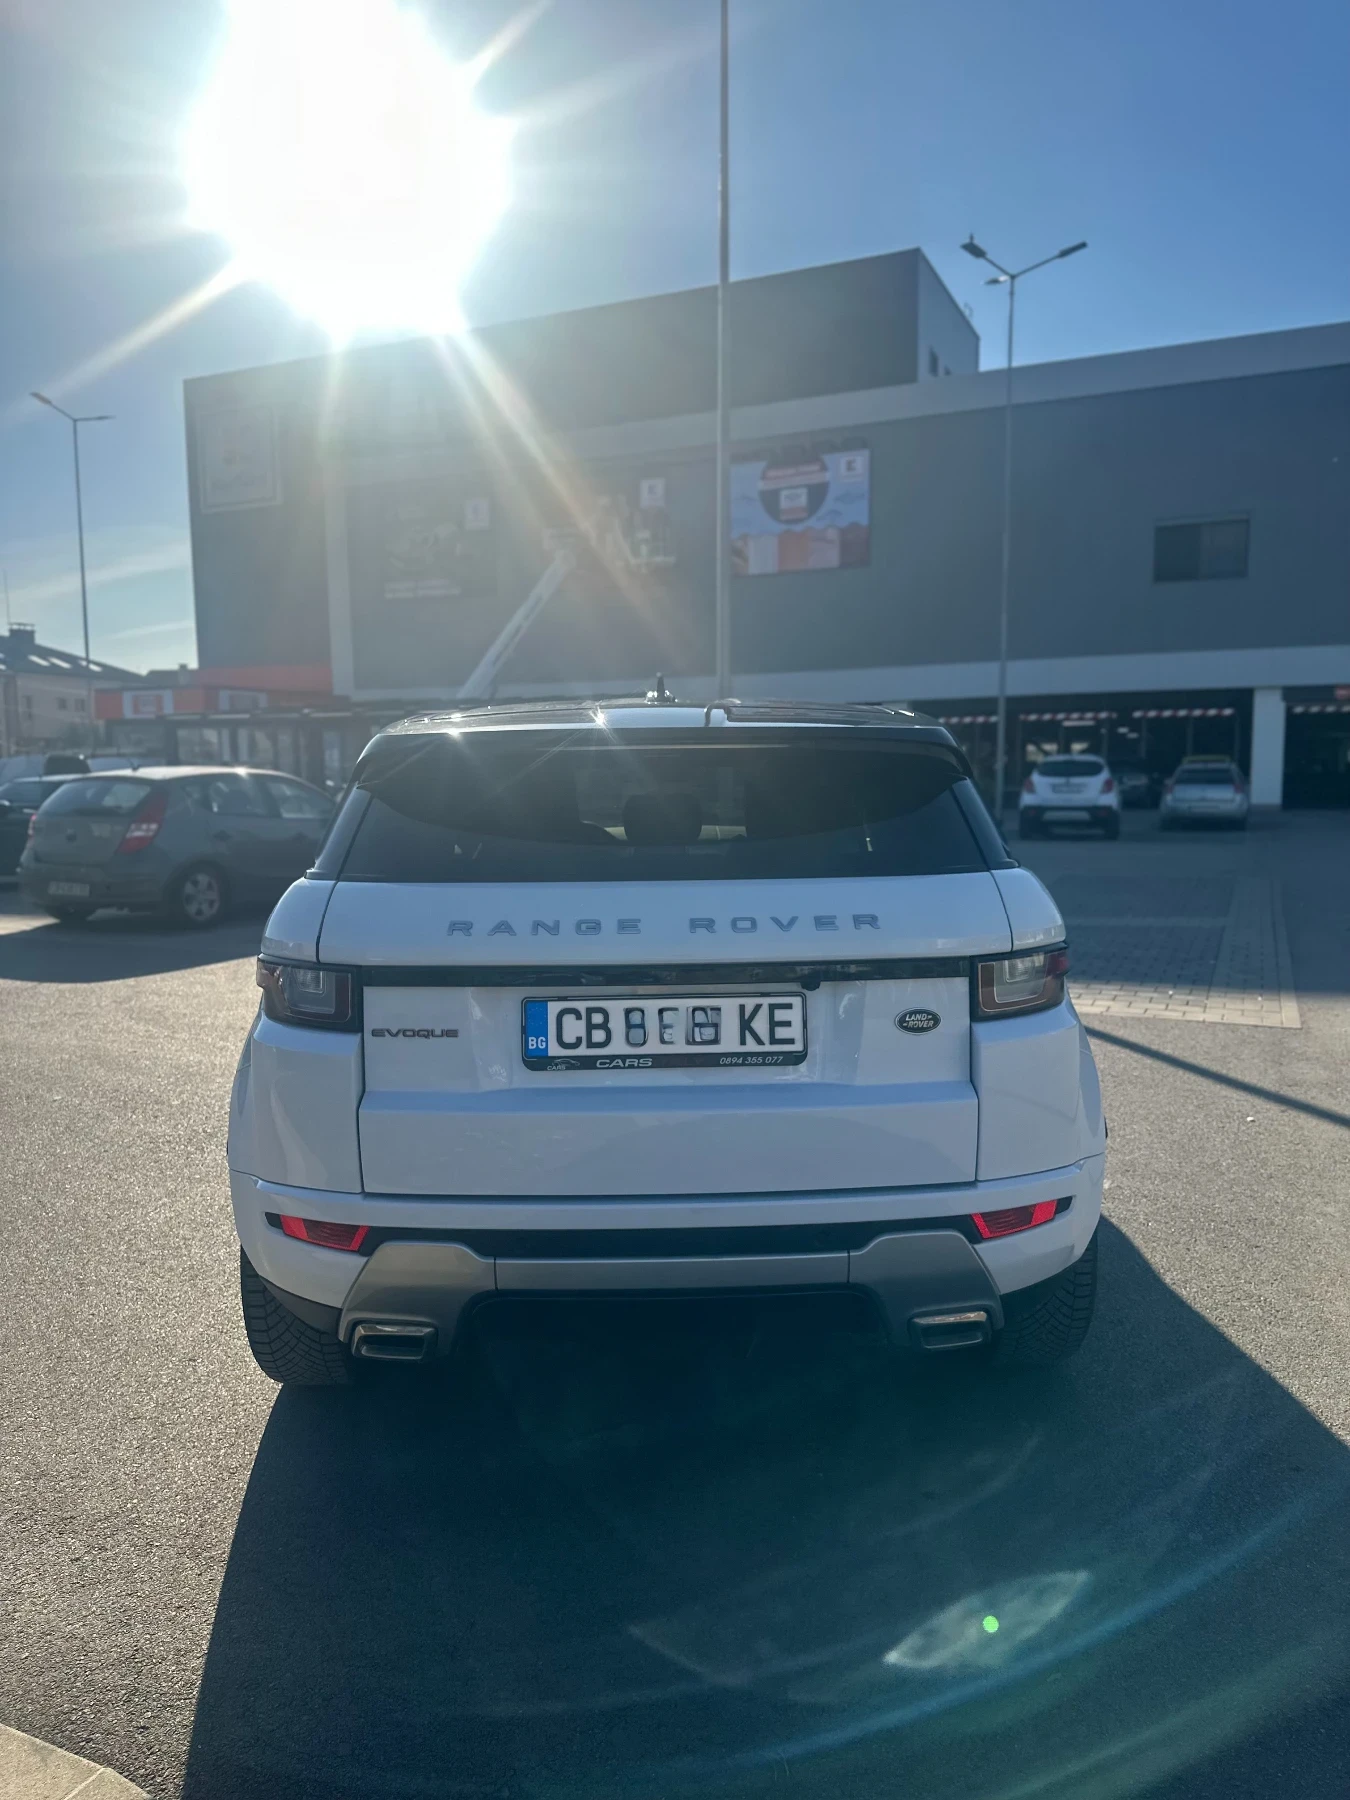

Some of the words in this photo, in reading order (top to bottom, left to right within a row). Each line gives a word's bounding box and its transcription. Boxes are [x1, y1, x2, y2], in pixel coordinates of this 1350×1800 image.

[447, 918, 642, 937] RANGE
[689, 913, 881, 934] ROVER
[555, 1006, 612, 1050] CB
[738, 1002, 796, 1046] KE
[371, 1028, 460, 1040] EVOQUE
[528, 1036, 547, 1049] BG
[596, 1058, 653, 1068] CARS
